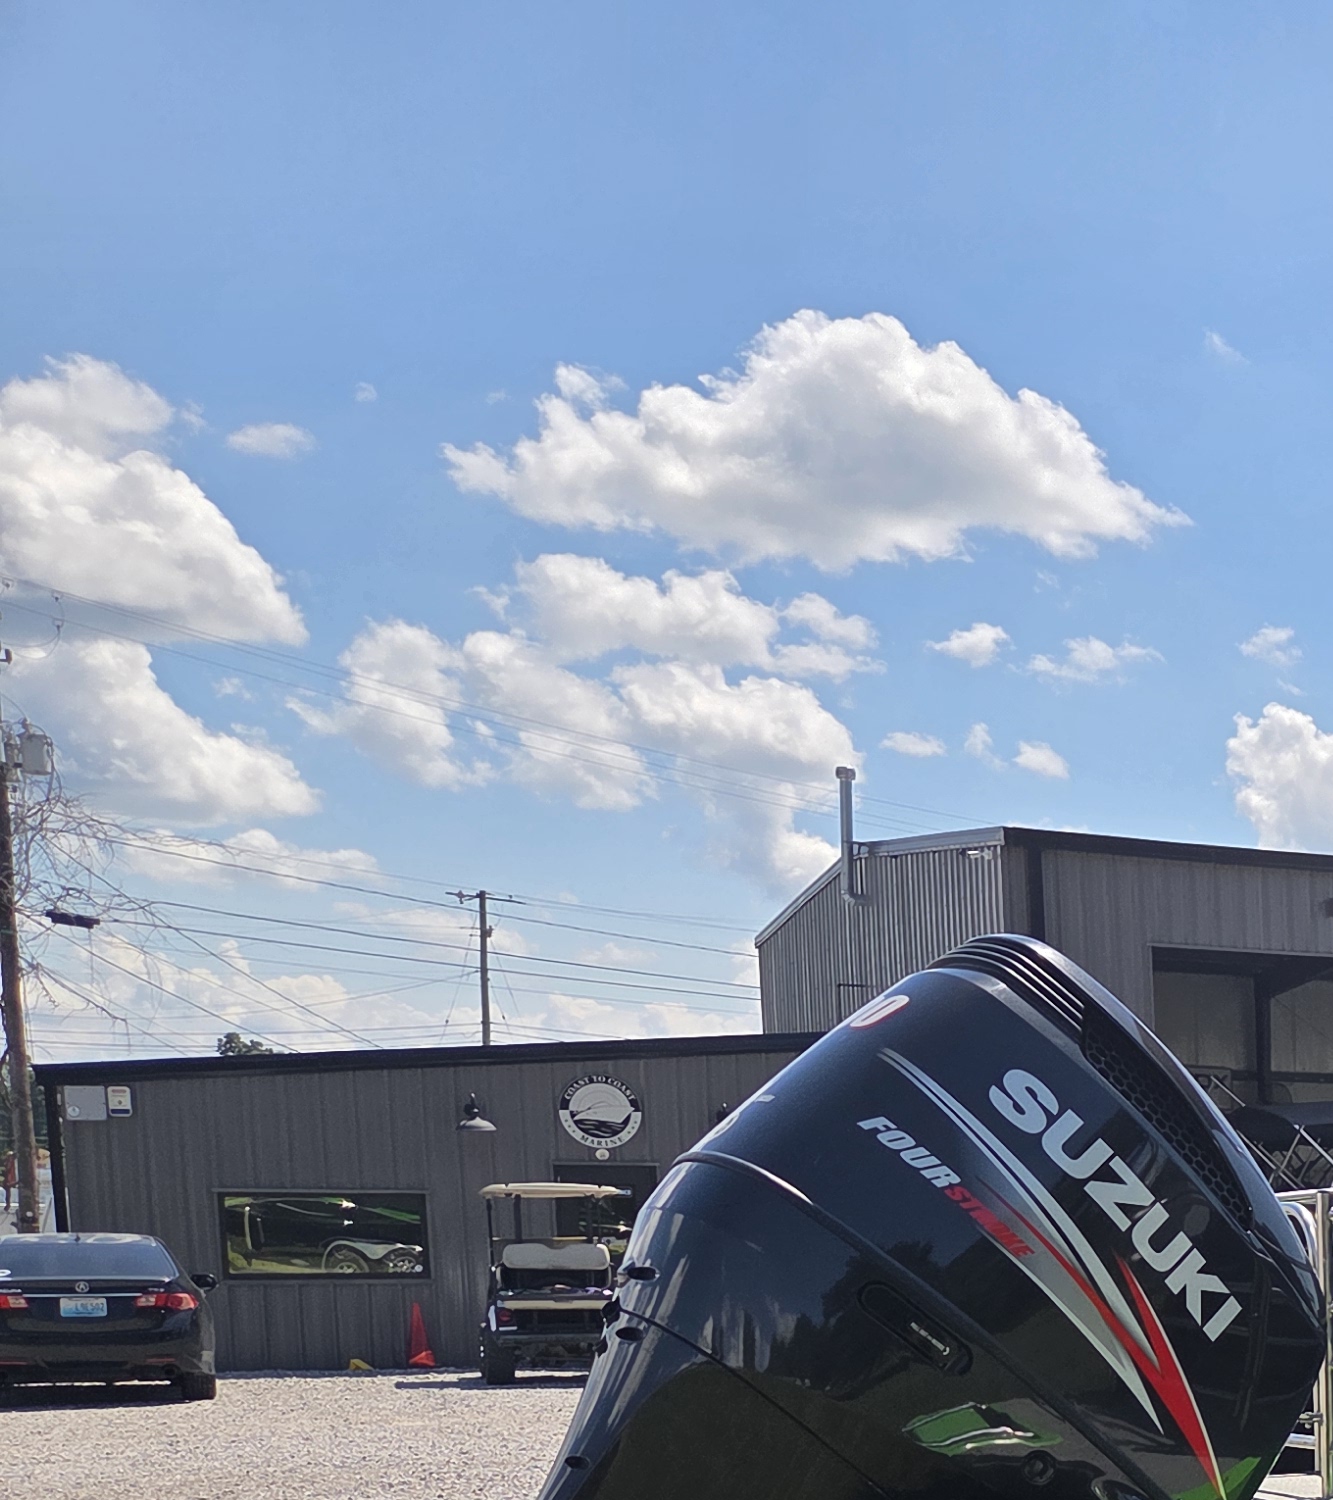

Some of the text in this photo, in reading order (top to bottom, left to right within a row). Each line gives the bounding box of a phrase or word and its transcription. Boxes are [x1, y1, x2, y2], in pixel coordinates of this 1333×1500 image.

[565, 1077, 590, 1100] COAST
[607, 1078, 636, 1100] COAST
[581, 1135, 624, 1147] MARINE
[988, 1068, 1243, 1342] SUZUKI
